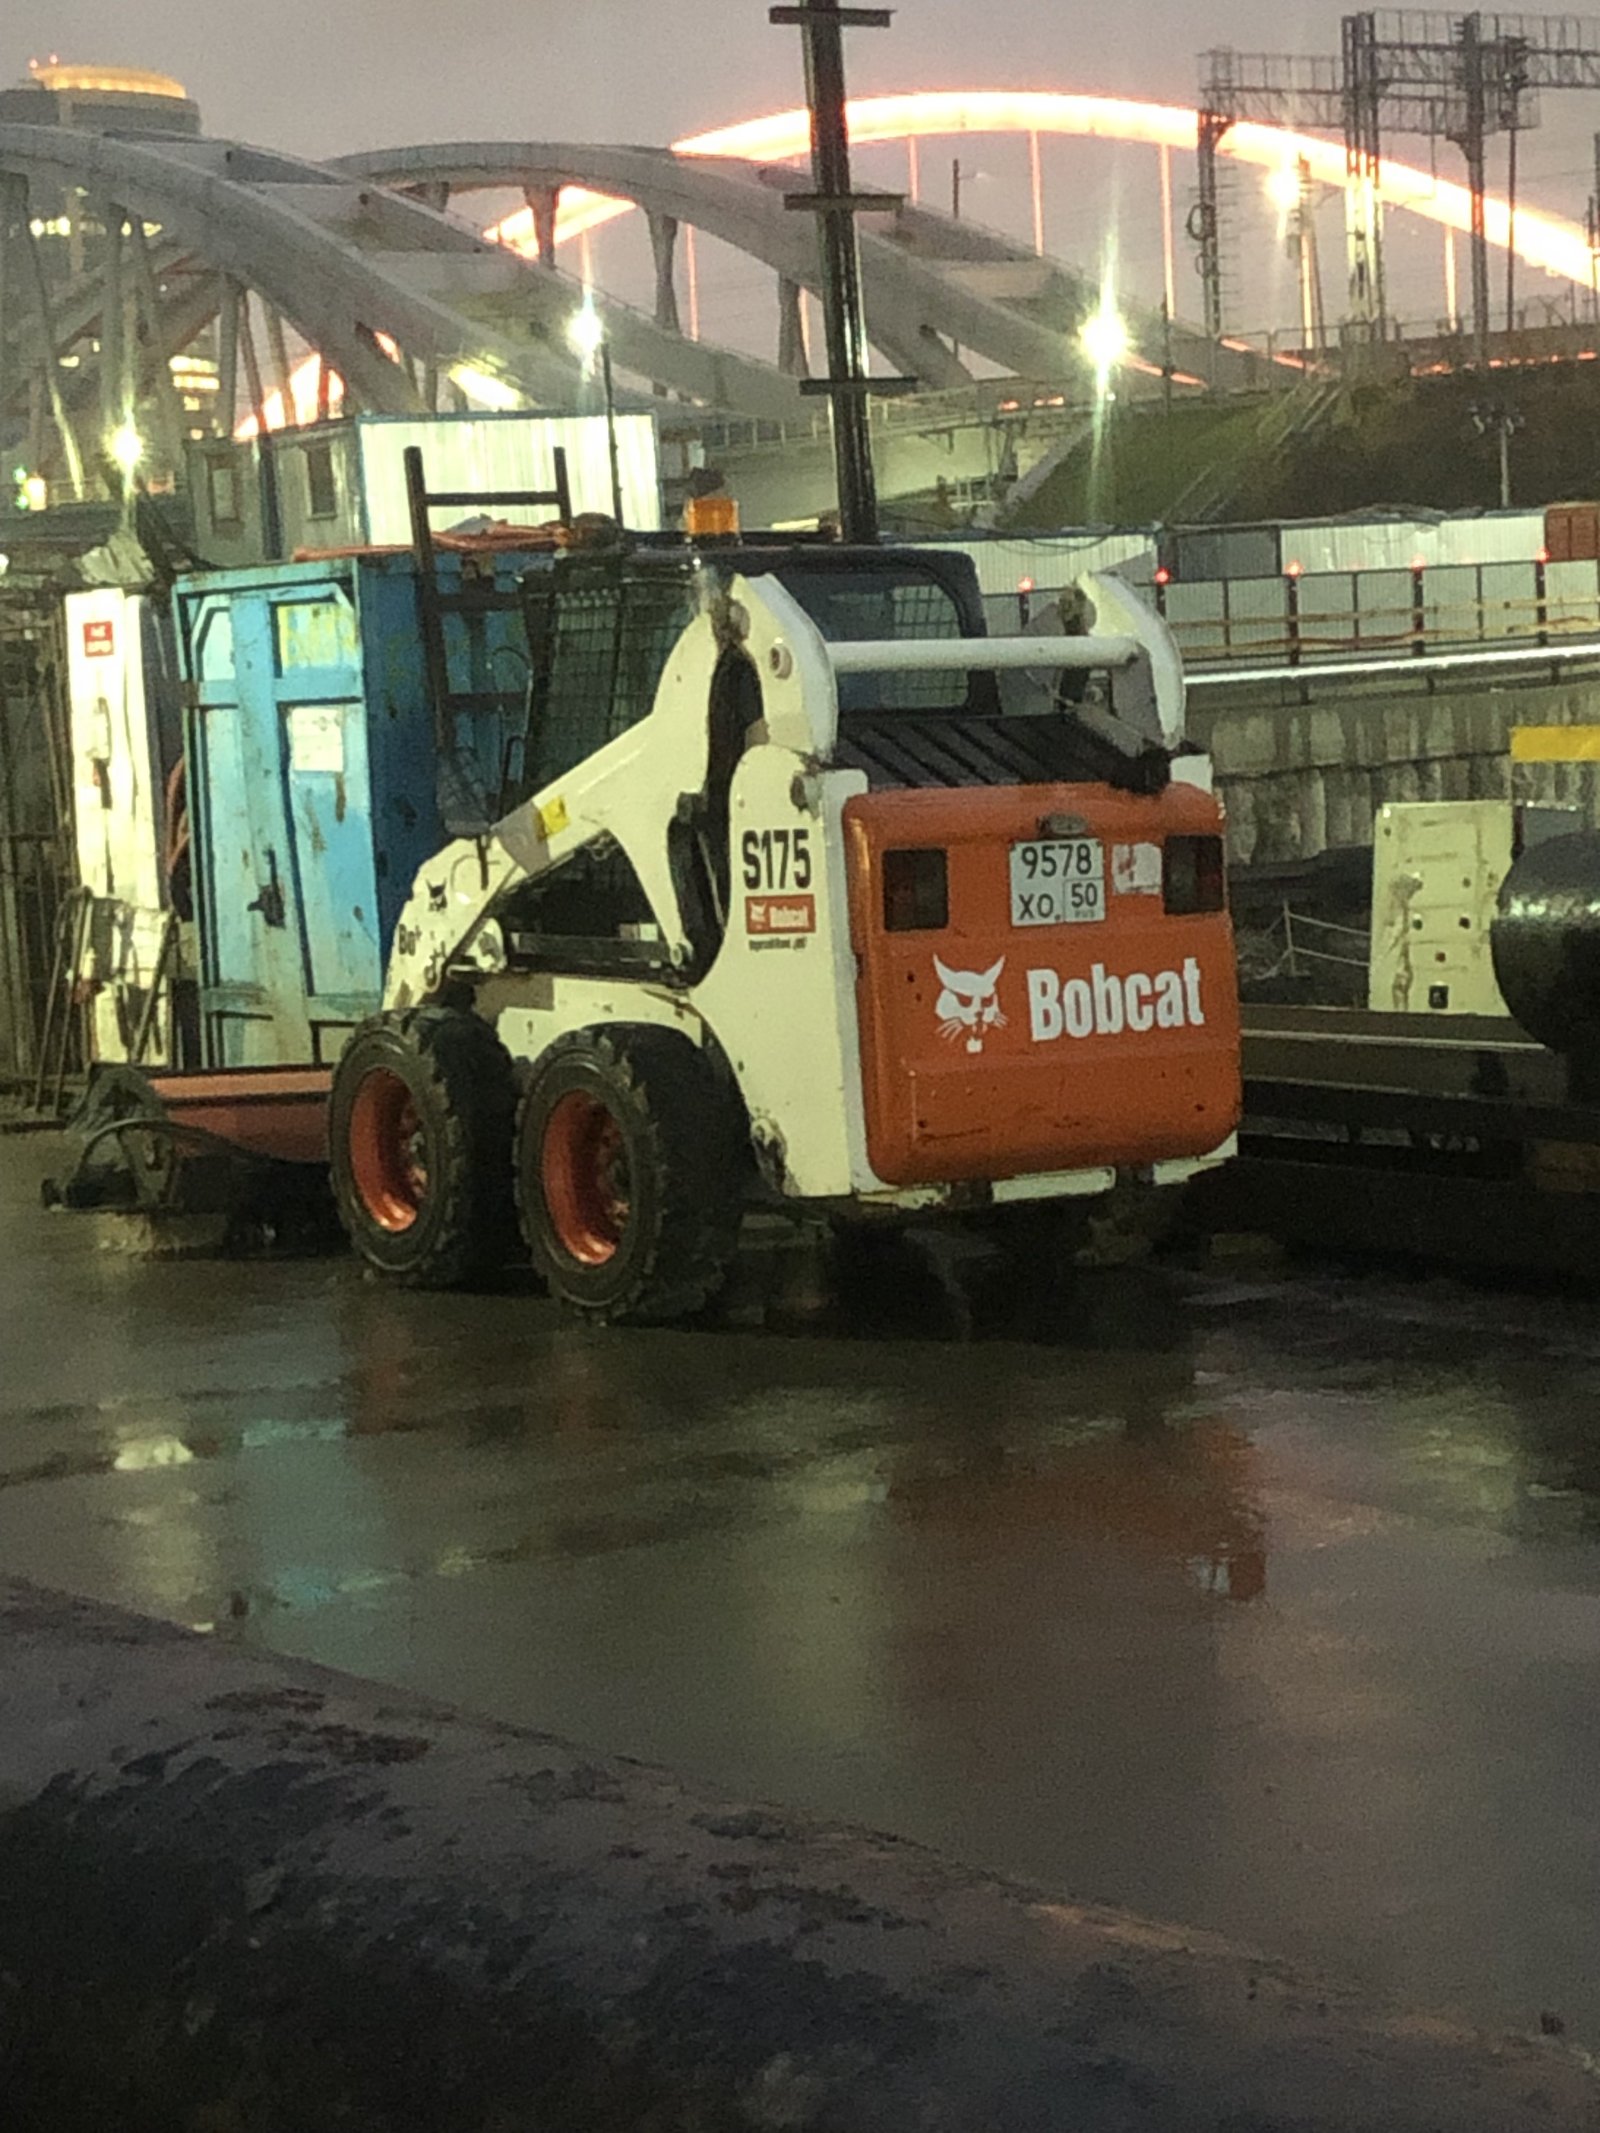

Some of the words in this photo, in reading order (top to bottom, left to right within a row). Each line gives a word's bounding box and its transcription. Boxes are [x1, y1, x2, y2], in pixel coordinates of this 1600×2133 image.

[742, 829, 811, 890] S175
[1021, 843, 1092, 880] 9578
[1071, 882, 1098, 908] 50
[1026, 957, 1205, 1042] Bobcat
